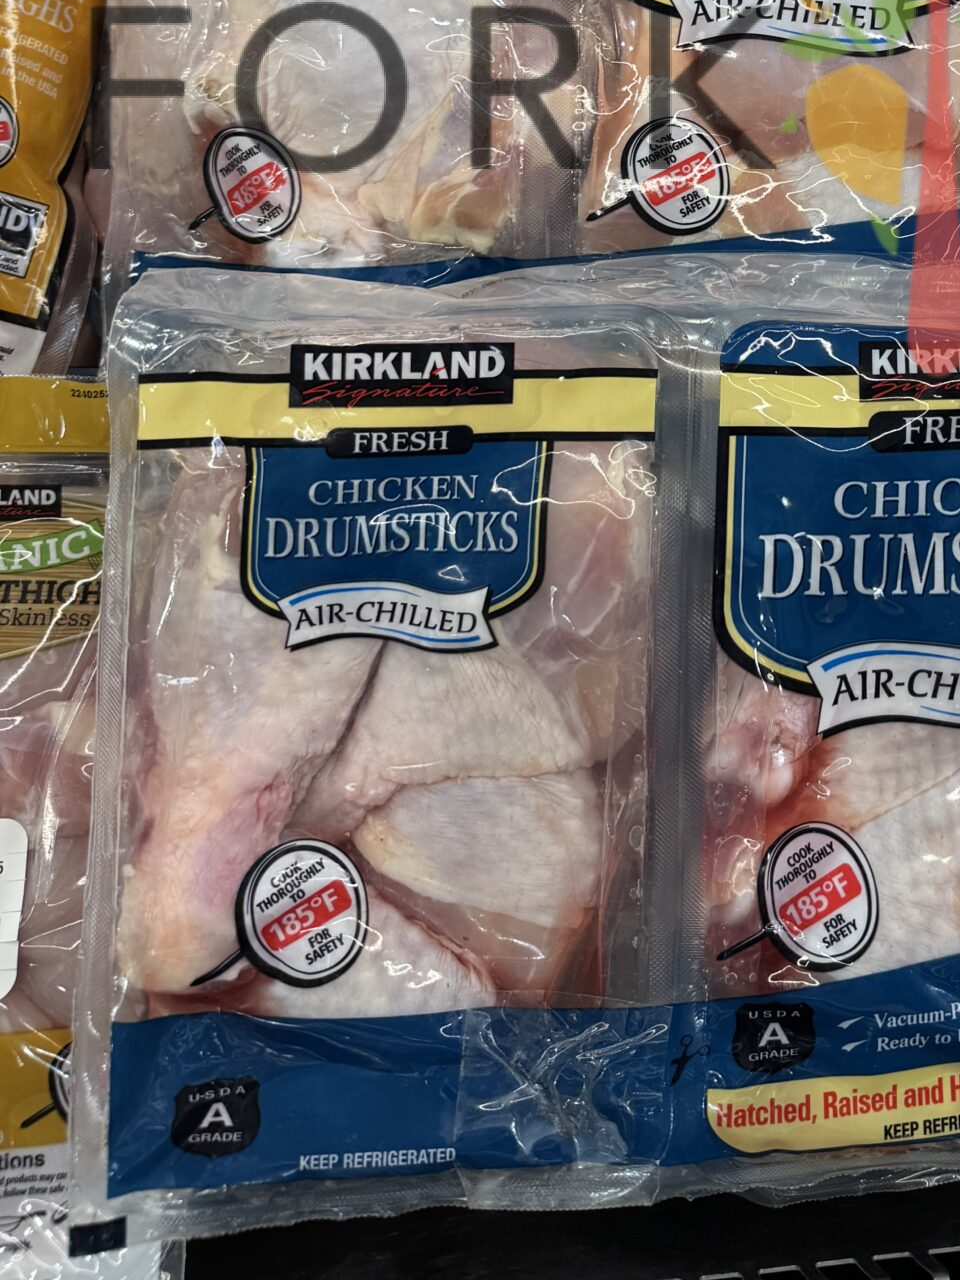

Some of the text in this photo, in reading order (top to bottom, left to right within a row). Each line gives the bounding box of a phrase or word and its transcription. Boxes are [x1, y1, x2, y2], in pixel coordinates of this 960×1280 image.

[637, 134, 695, 169] THOROUGHLY
[679, 196, 712, 219] SAFETY
[681, 190, 701, 206] FOR
[304, 350, 506, 381] KIRKLAND
[302, 381, 505, 408] Signature
[352, 429, 450, 455] FRESH
[307, 474, 480, 507] CHICKEN
[264, 510, 520, 560] DRUMSTICKS
[294, 601, 478, 635] AIR-CHILLED
[775, 841, 836, 892] THOROUGHLY
[787, 841, 815, 868] COOK
[256, 857, 327, 913] THOROUGHLY
[270, 860, 302, 889] COOK
[803, 869, 817, 884] TO
[289, 888, 306, 903] TO
[785, 872, 850, 926] 185°F
[268, 888, 340, 945] 185°F
[824, 913, 846, 934] FOR
[308, 928, 332, 950] FOR
[822, 919, 859, 950] SAFETY
[304, 933, 346, 966] SAFETY
[748, 1010, 801, 1019] USDA
[758, 1022, 790, 1047] A
[876, 1031, 930, 1054] Ready
[934, 1029, 952, 1045] to
[748, 1048, 799, 1062] GRADE
[188, 1085, 247, 1104] USDA
[715, 1094, 817, 1131] Hatched,
[823, 1087, 898, 1121] Raised
[903, 1078, 945, 1108] and
[199, 1102, 235, 1128] A
[188, 1130, 243, 1144] GRADE
[884, 1120, 920, 1141] KEEP
[300, 1147, 456, 1171] KEEP REFRIGERATED
